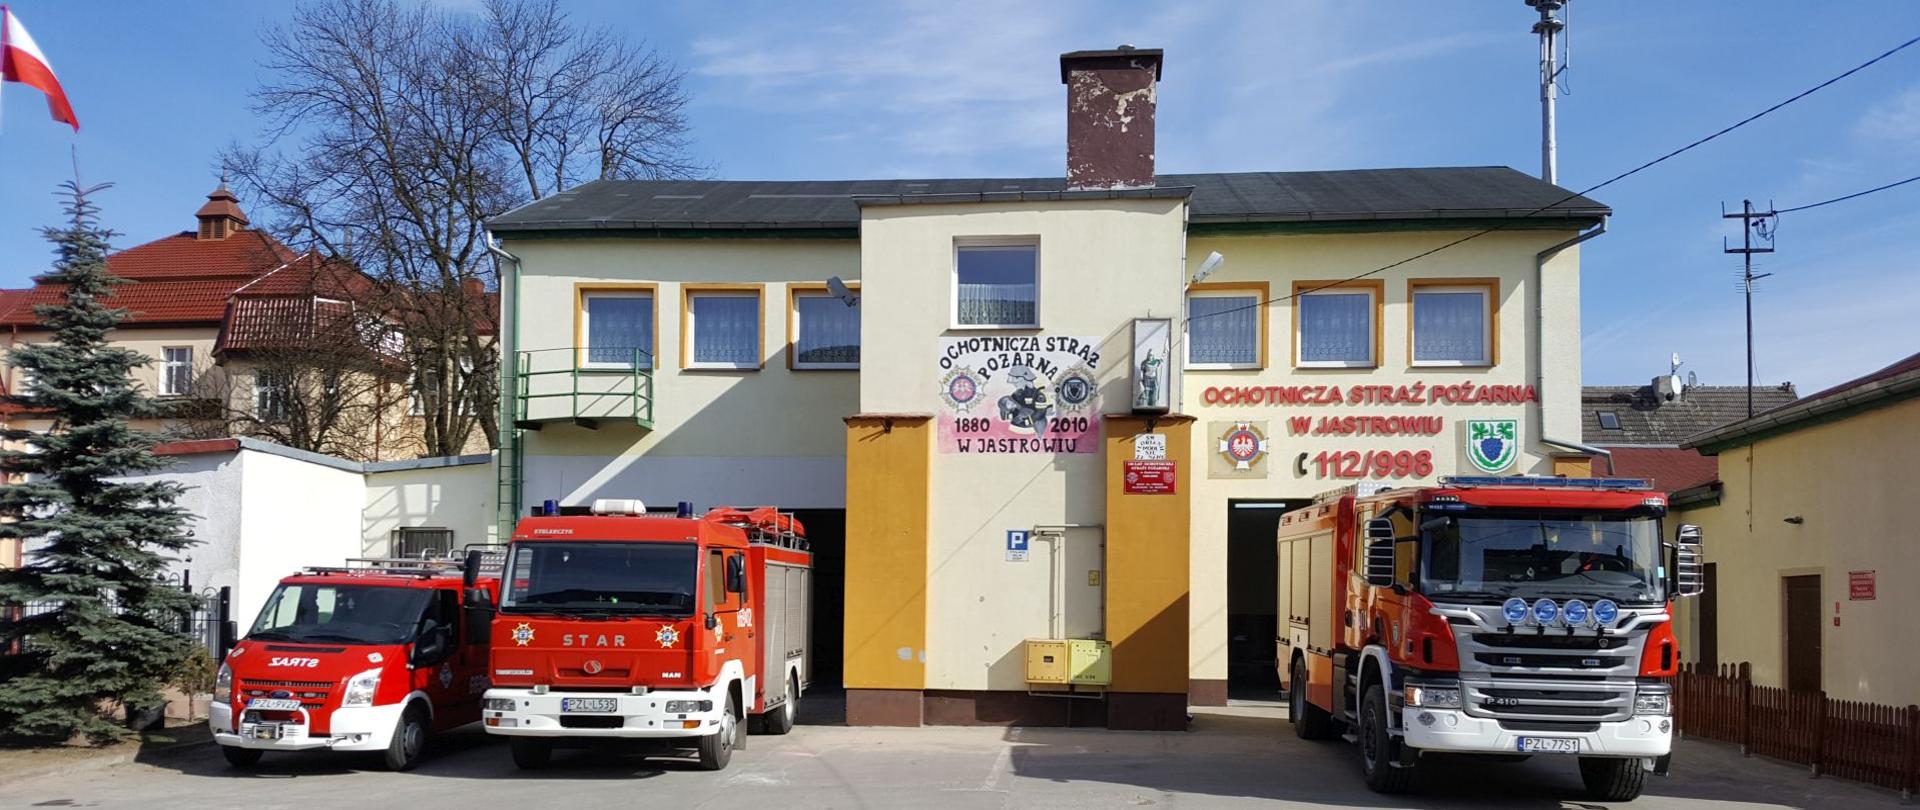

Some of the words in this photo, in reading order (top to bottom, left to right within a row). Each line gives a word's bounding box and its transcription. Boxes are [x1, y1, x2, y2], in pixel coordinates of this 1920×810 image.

[939, 336, 1040, 370] OCHOTNICZA
[1203, 385, 1344, 405] OCHOTNICZA
[954, 417, 990, 433] 1880
[1050, 416, 1088, 433] 2010
[1290, 416, 1312, 434] W
[1312, 416, 1443, 434] JASTROWIU
[957, 438, 971, 453] W
[977, 438, 1077, 453] JASTROWIU
[1310, 450, 1433, 478] 112/998
[1011, 532, 1024, 549] P
[563, 634, 625, 647] STAR
[569, 699, 589, 710] PZL
[1497, 698, 1518, 706] 410
[1525, 738, 1547, 750] PZL
[1551, 739, 1577, 751] 77S1
